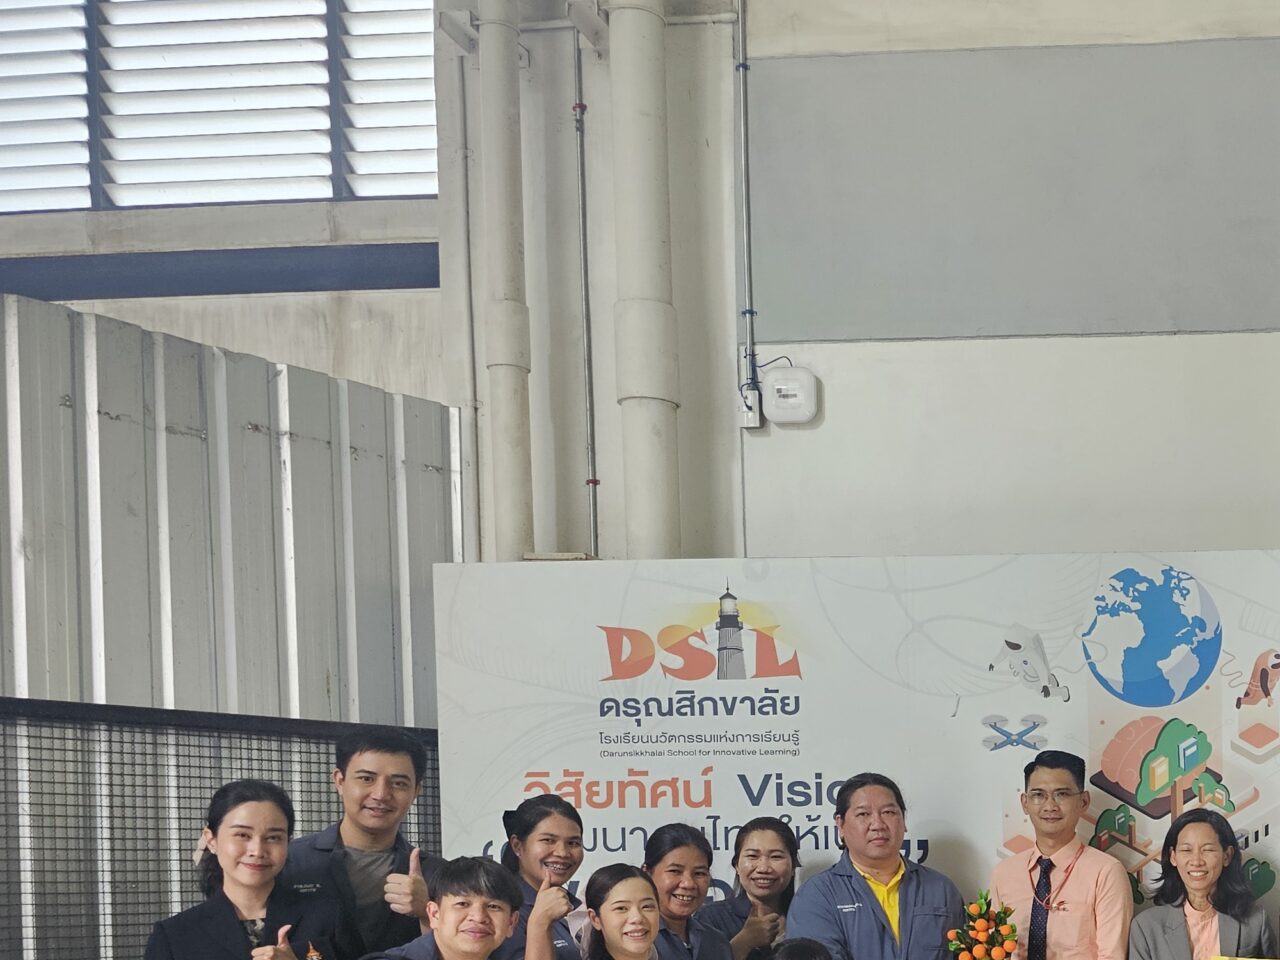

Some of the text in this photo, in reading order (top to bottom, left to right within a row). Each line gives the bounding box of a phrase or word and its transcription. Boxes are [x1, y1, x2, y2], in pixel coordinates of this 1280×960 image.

[599, 687, 800, 727] ดรุณสิกขาลัย
[599, 730, 800, 747] โรงเรียนนวัตกรรมแห่งการเรียนรู้
[600, 748, 801, 759] (Darunsikkhalai School for Innovative Learning)
[737, 772, 847, 807] Visi
